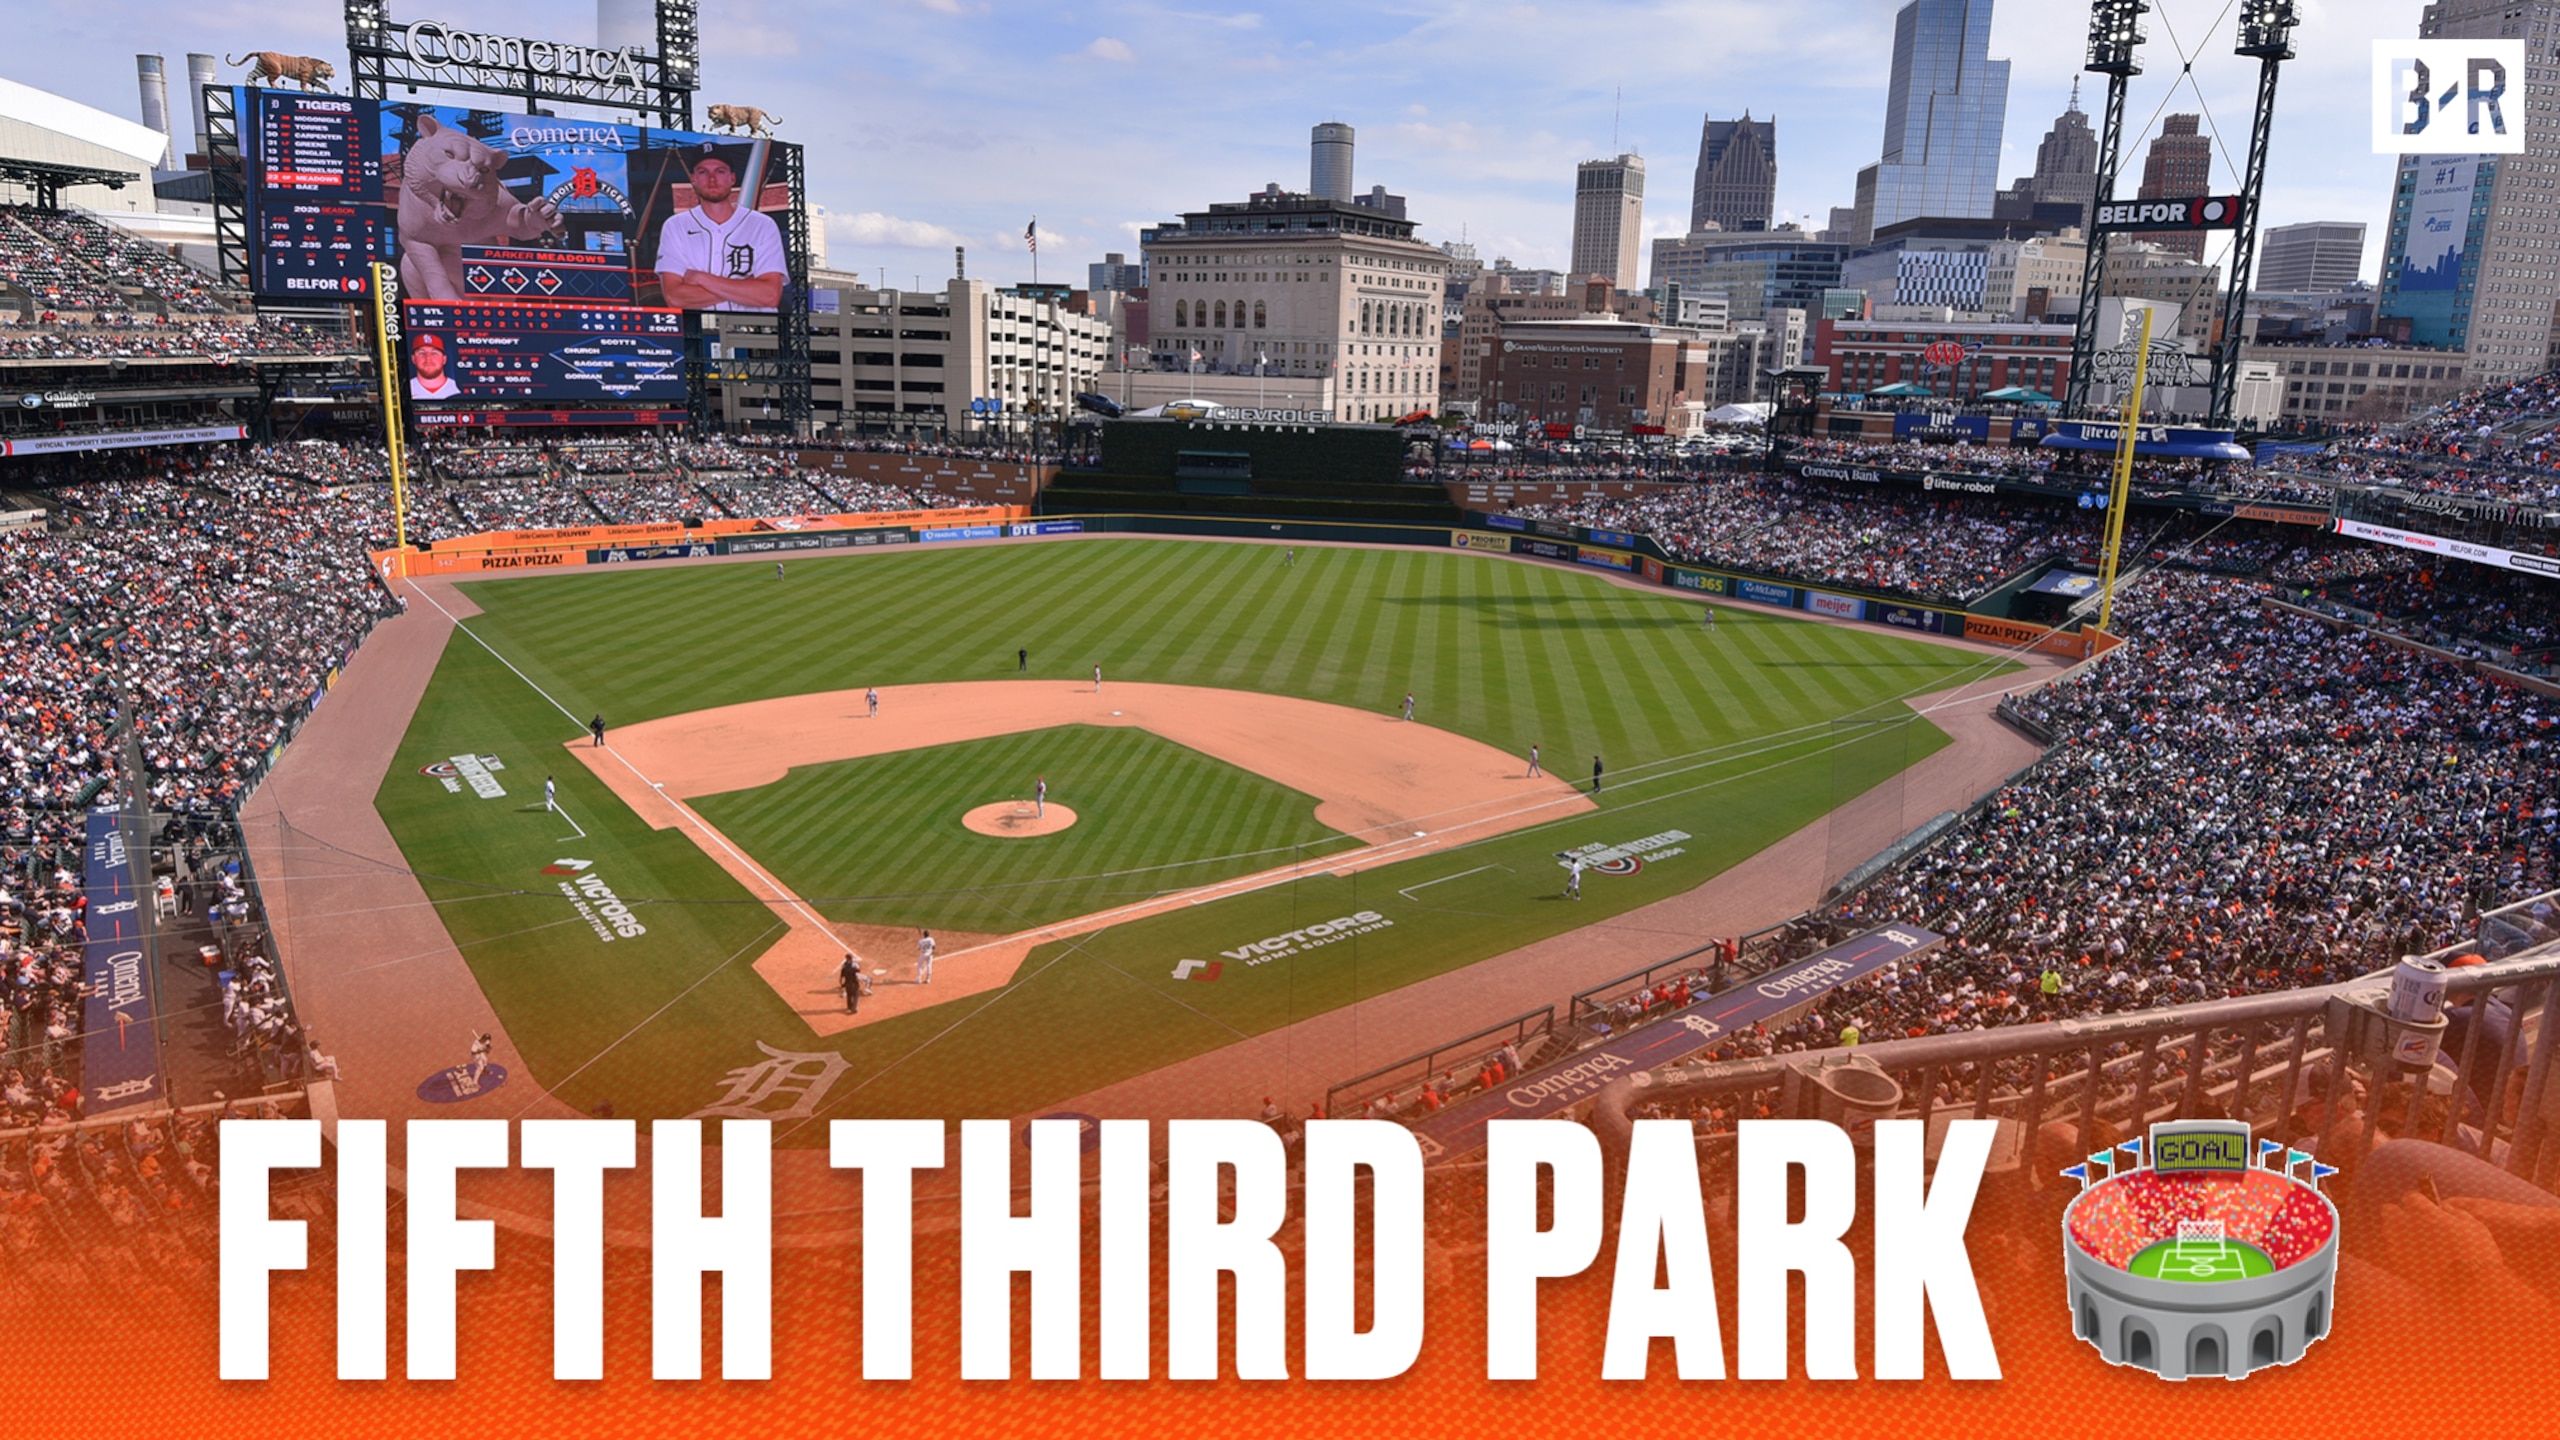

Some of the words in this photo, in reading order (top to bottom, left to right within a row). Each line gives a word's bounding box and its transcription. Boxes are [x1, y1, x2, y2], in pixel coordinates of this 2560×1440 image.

[478, 69, 590, 96] PARK
[295, 100, 352, 112] TIGERS
[294, 132, 343, 140] CARPENTER
[294, 141, 328, 149] GREENE
[545, 148, 595, 156] PARK
[295, 149, 331, 157] DINGLER
[2431, 156, 2467, 166] MICHIGAN'S
[295, 166, 344, 174] TORKELSON
[2435, 167, 2456, 185] #1
[295, 175, 339, 183] MEADOWS
[2433, 185, 2469, 194] INSURANCE
[600, 183, 632, 216] TIGERS
[2099, 203, 2186, 224] BELFOR
[484, 249, 534, 260] PARKER
[536, 253, 606, 264] MEADOWS
[287, 278, 338, 290] BELFOR
[383, 281, 402, 342] Rocket
[424, 319, 444, 327] DET
[653, 314, 677, 324] 1-2
[44, 391, 96, 402] Gallagher
[333, 410, 370, 420] MARKET
[420, 415, 456, 423] BELFOR
[1213, 407, 1333, 423] CHEVROLET
[1930, 412, 1956, 427] Lite
[1188, 423, 1316, 434] FOUNTAIN
[1474, 421, 1519, 437] meijer
[2081, 425, 2103, 441] Lite
[35, 441, 64, 449] OFFICIAL
[66, 438, 99, 447] PROPERTY
[101, 436, 142, 445] RESTORATION
[143, 433, 172, 442] COMPANY
[1644, 434, 1666, 443] LAW
[834, 454, 844, 462] 23
[944, 461, 949, 469] 2
[924, 474, 933, 482] 47
[1852, 468, 1880, 483] Bank
[1623, 483, 1634, 492] 42
[1934, 477, 1995, 494] litter-robot
[2473, 504, 2505, 522] TIGER
[556, 530, 591, 539] DELIVERY
[646, 525, 678, 534] DELIVERY
[1012, 524, 1037, 536] DTE
[1471, 535, 1506, 544] PRIORITY
[2356, 526, 2372, 535] BELFOR
[2381, 531, 2405, 541] PROPERTY
[2450, 544, 2488, 558] BELFOR.COM
[482, 558, 522, 569] PIZZA!
[524, 555, 563, 566] PIZZA!
[1677, 573, 1723, 592] bet365
[1753, 584, 1788, 598] McLaren
[1816, 597, 1852, 613] meijer
[1887, 612, 1917, 626] Corona
[1966, 621, 2003, 637] PIZZA!
[557, 881, 582, 904] HOME
[573, 901, 615, 943] SOLUTIONS
[575, 872, 646, 939] VICTORS
[1219, 910, 1383, 960] VICTORS
[1246, 948, 1299, 967] HOME
[1301, 919, 1394, 950] SOLUTIONS
[1799, 974, 1843, 995] PARK
[1664, 1070, 1689, 1084] 325
[1751, 1060, 1768, 1073] 12
[1557, 1073, 1614, 1101] PARK
